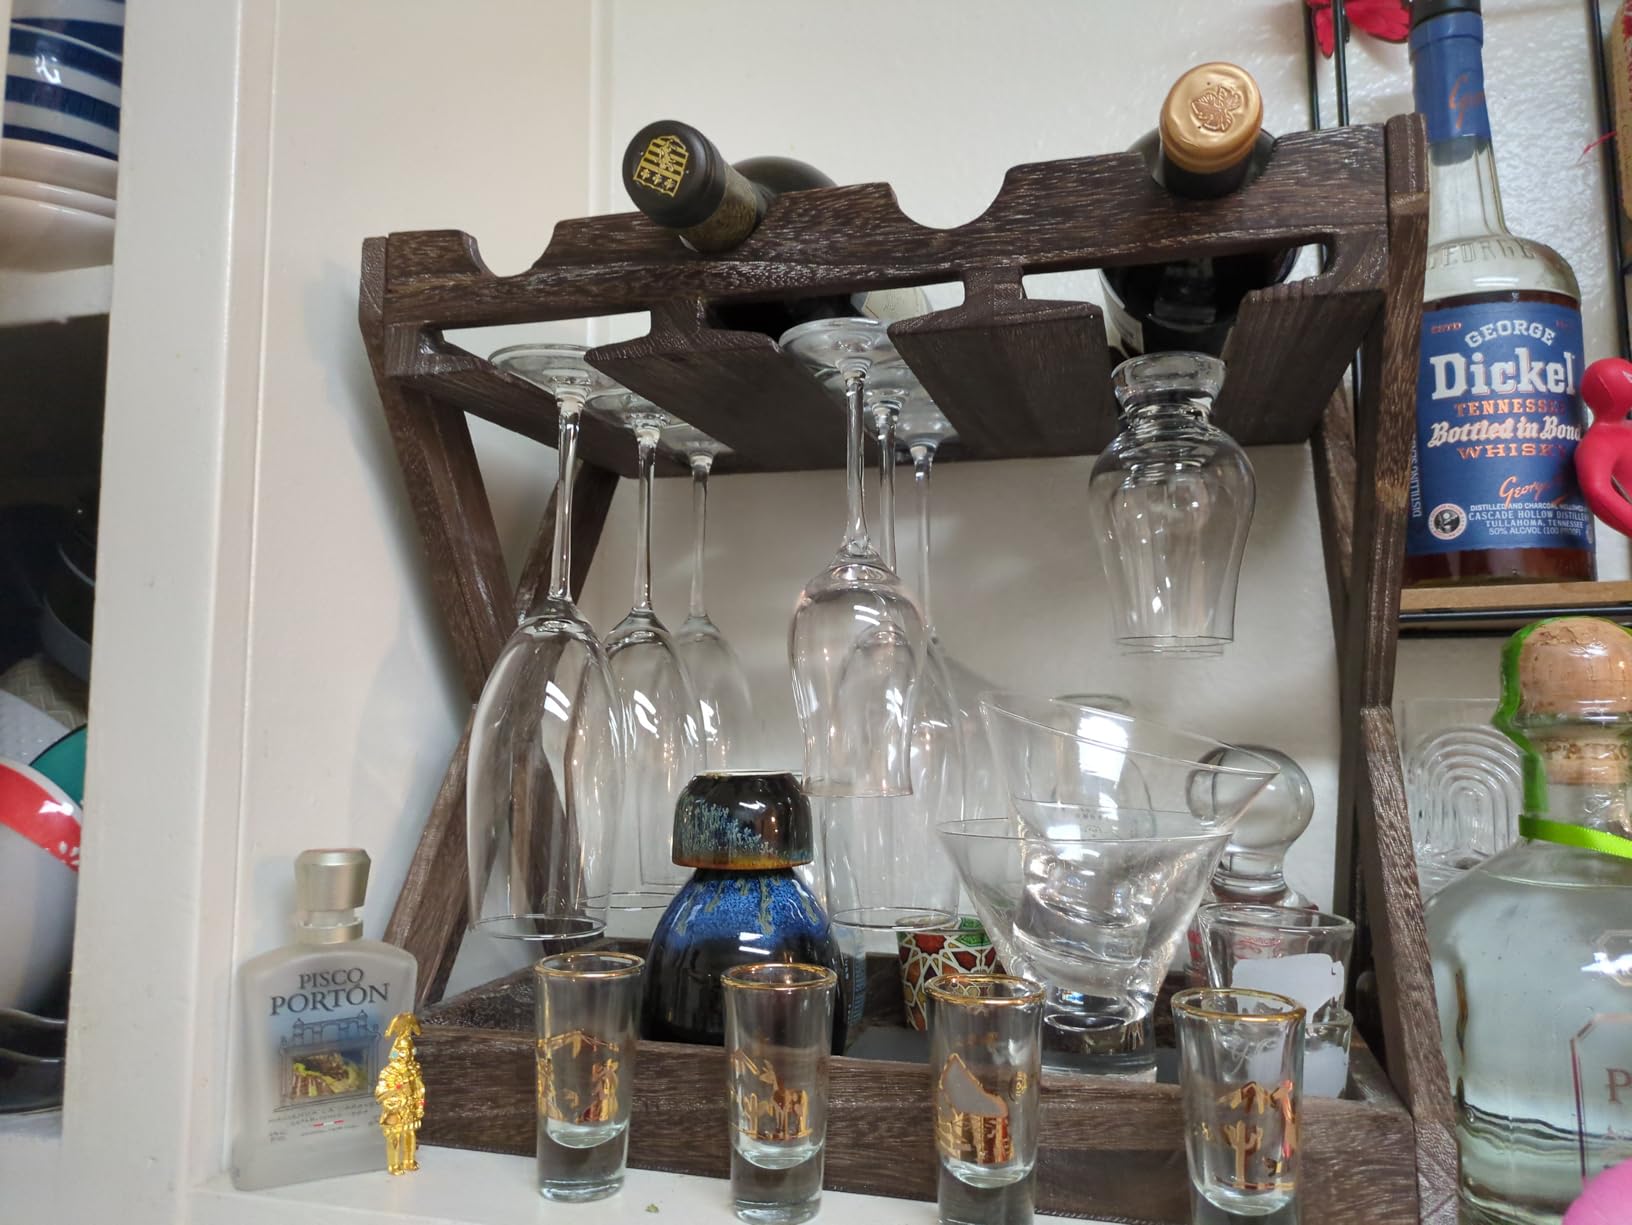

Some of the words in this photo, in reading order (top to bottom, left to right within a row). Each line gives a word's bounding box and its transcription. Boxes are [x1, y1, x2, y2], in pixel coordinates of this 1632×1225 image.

[1465, 320, 1556, 348] GEORGE
[1429, 347, 1576, 399] Dickel
[1427, 417, 1515, 448] Bottled
[1516, 416, 1540, 439] in
[1468, 510, 1514, 520] CASCADE
[1517, 510, 1553, 519] HOLLOW
[298, 967, 364, 990] PISCO
